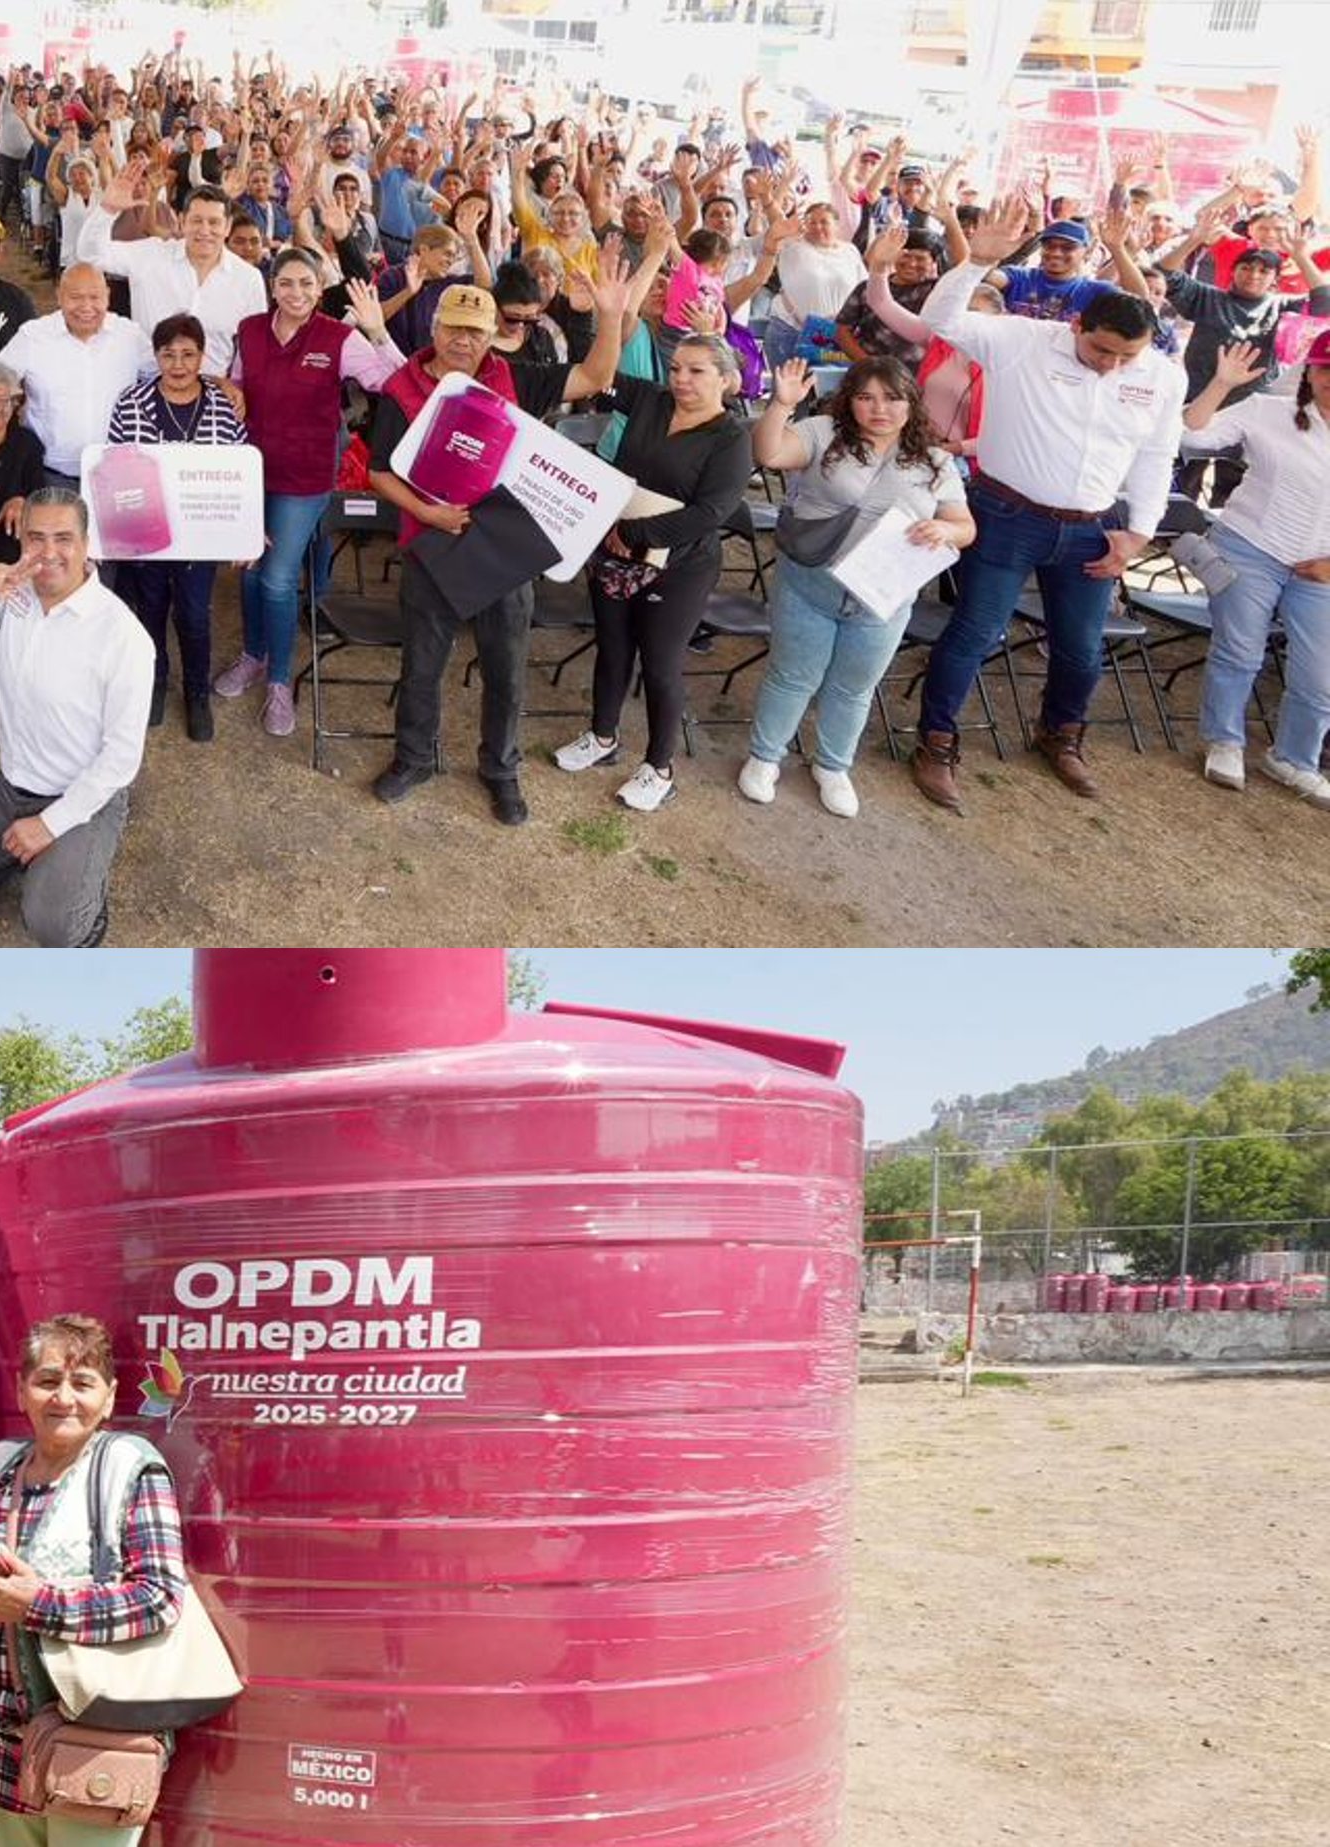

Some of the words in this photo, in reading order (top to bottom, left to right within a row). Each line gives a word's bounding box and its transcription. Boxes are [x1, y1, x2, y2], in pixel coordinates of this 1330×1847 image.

[178, 469, 242, 482] ENTREGA
[529, 453, 598, 503] ENTREGA
[174, 1256, 434, 1309] OPDM
[137, 1311, 481, 1361] Tlalnepantla
[211, 1371, 338, 1394] nuestra
[343, 1366, 466, 1394] ciudad
[294, 1787, 354, 1808] 5,000
